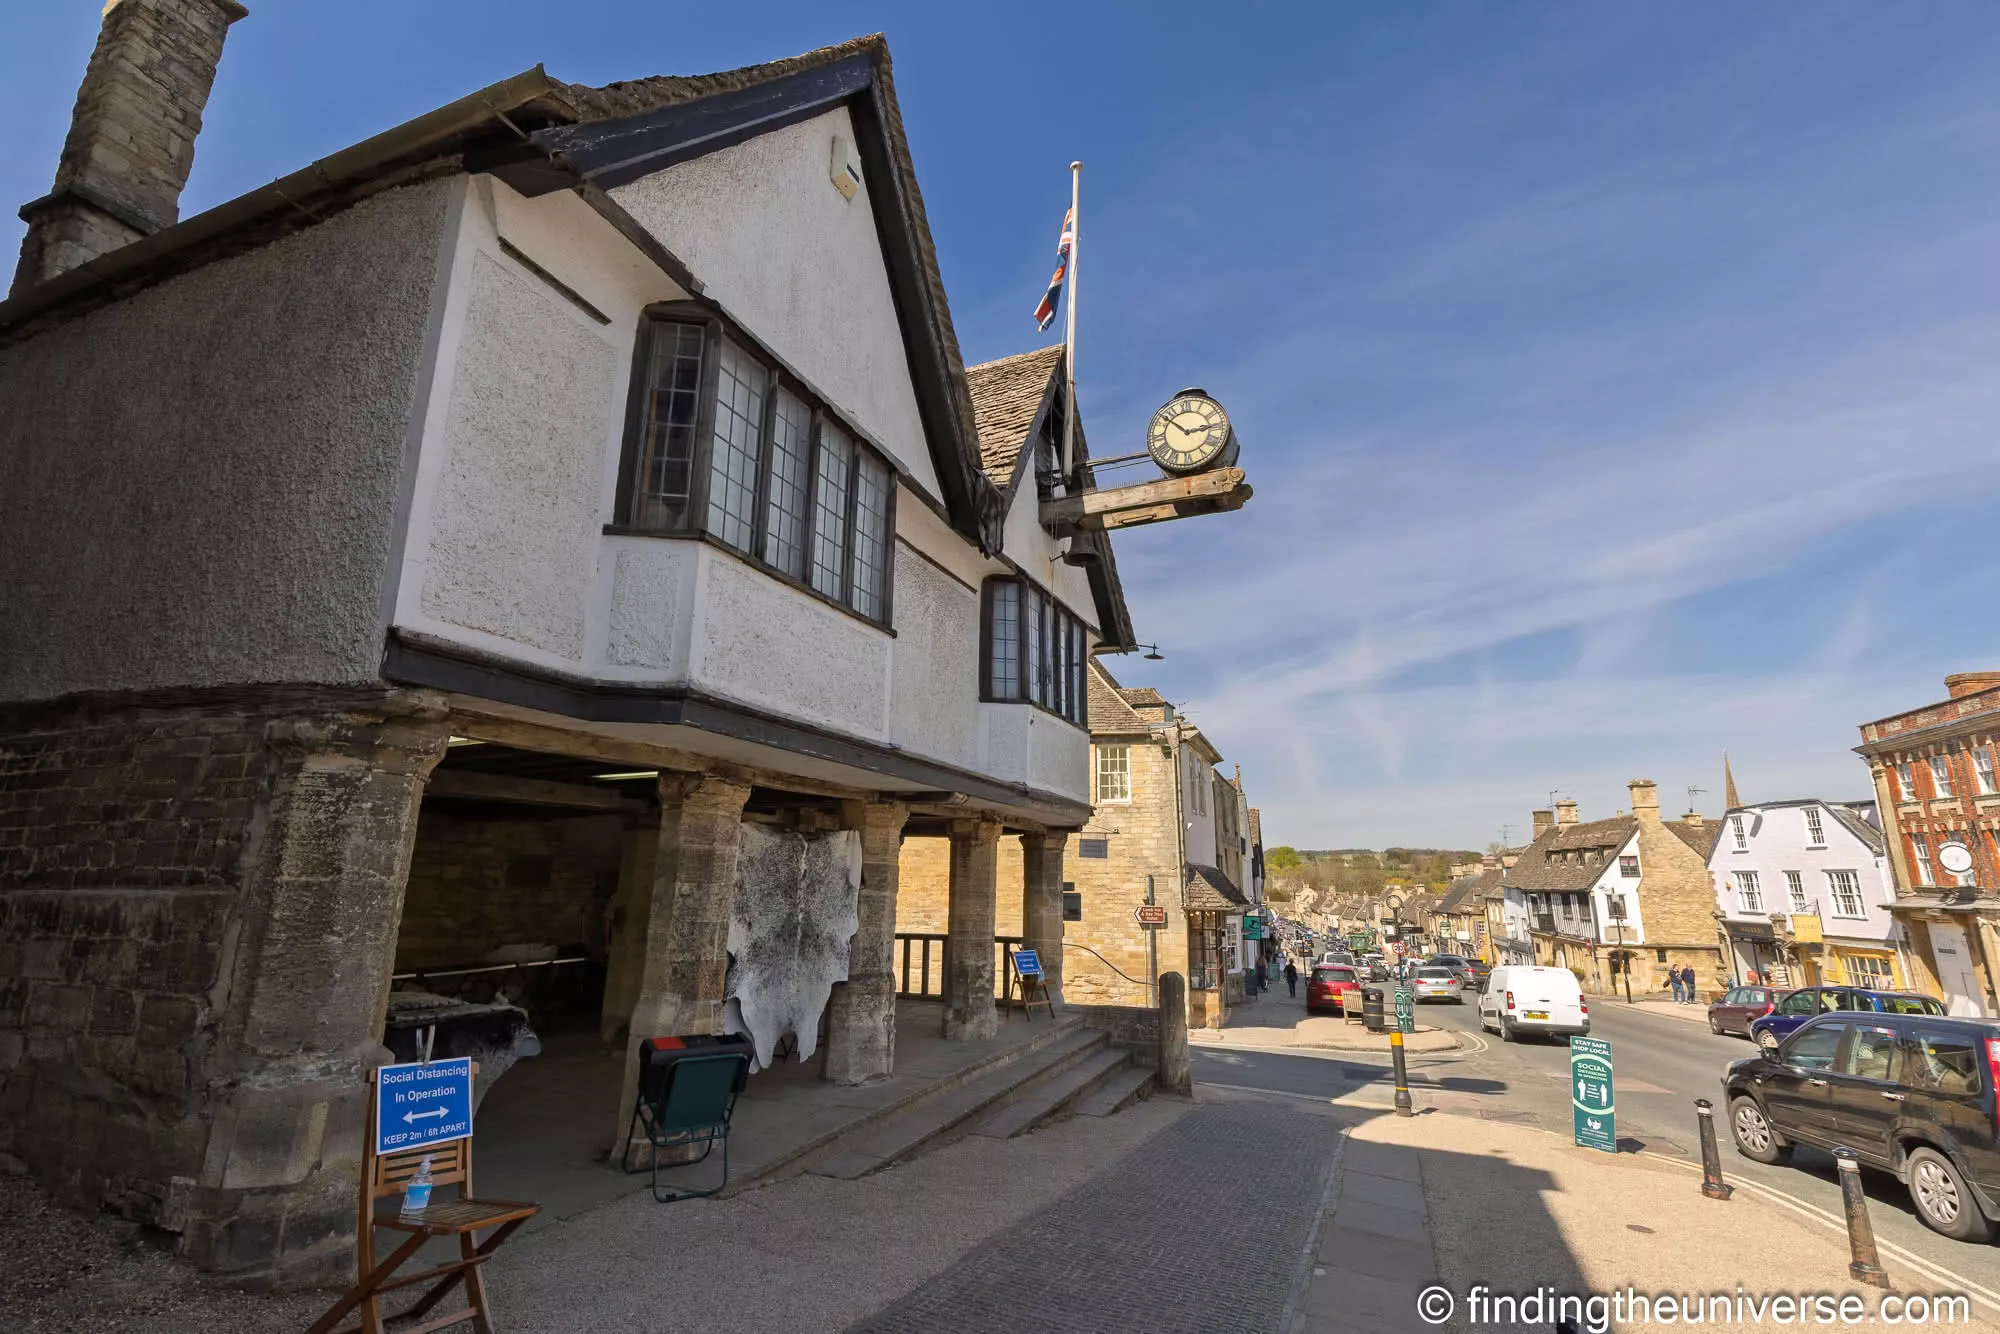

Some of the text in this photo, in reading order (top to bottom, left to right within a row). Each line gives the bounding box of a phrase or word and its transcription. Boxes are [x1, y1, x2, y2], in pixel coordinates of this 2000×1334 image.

[1575, 1039, 1607, 1049] STAY SAFE
[1589, 1047, 1610, 1056] LOCAL
[1577, 1062, 1607, 1073] SOCIAL
[383, 1066, 467, 1085] Social Distancing
[395, 1086, 456, 1103] In Operation
[384, 1133, 408, 1145] KEEP
[409, 1131, 422, 1141] 2m
[428, 1126, 439, 1137] 6ft
[439, 1121, 466, 1135] APART
